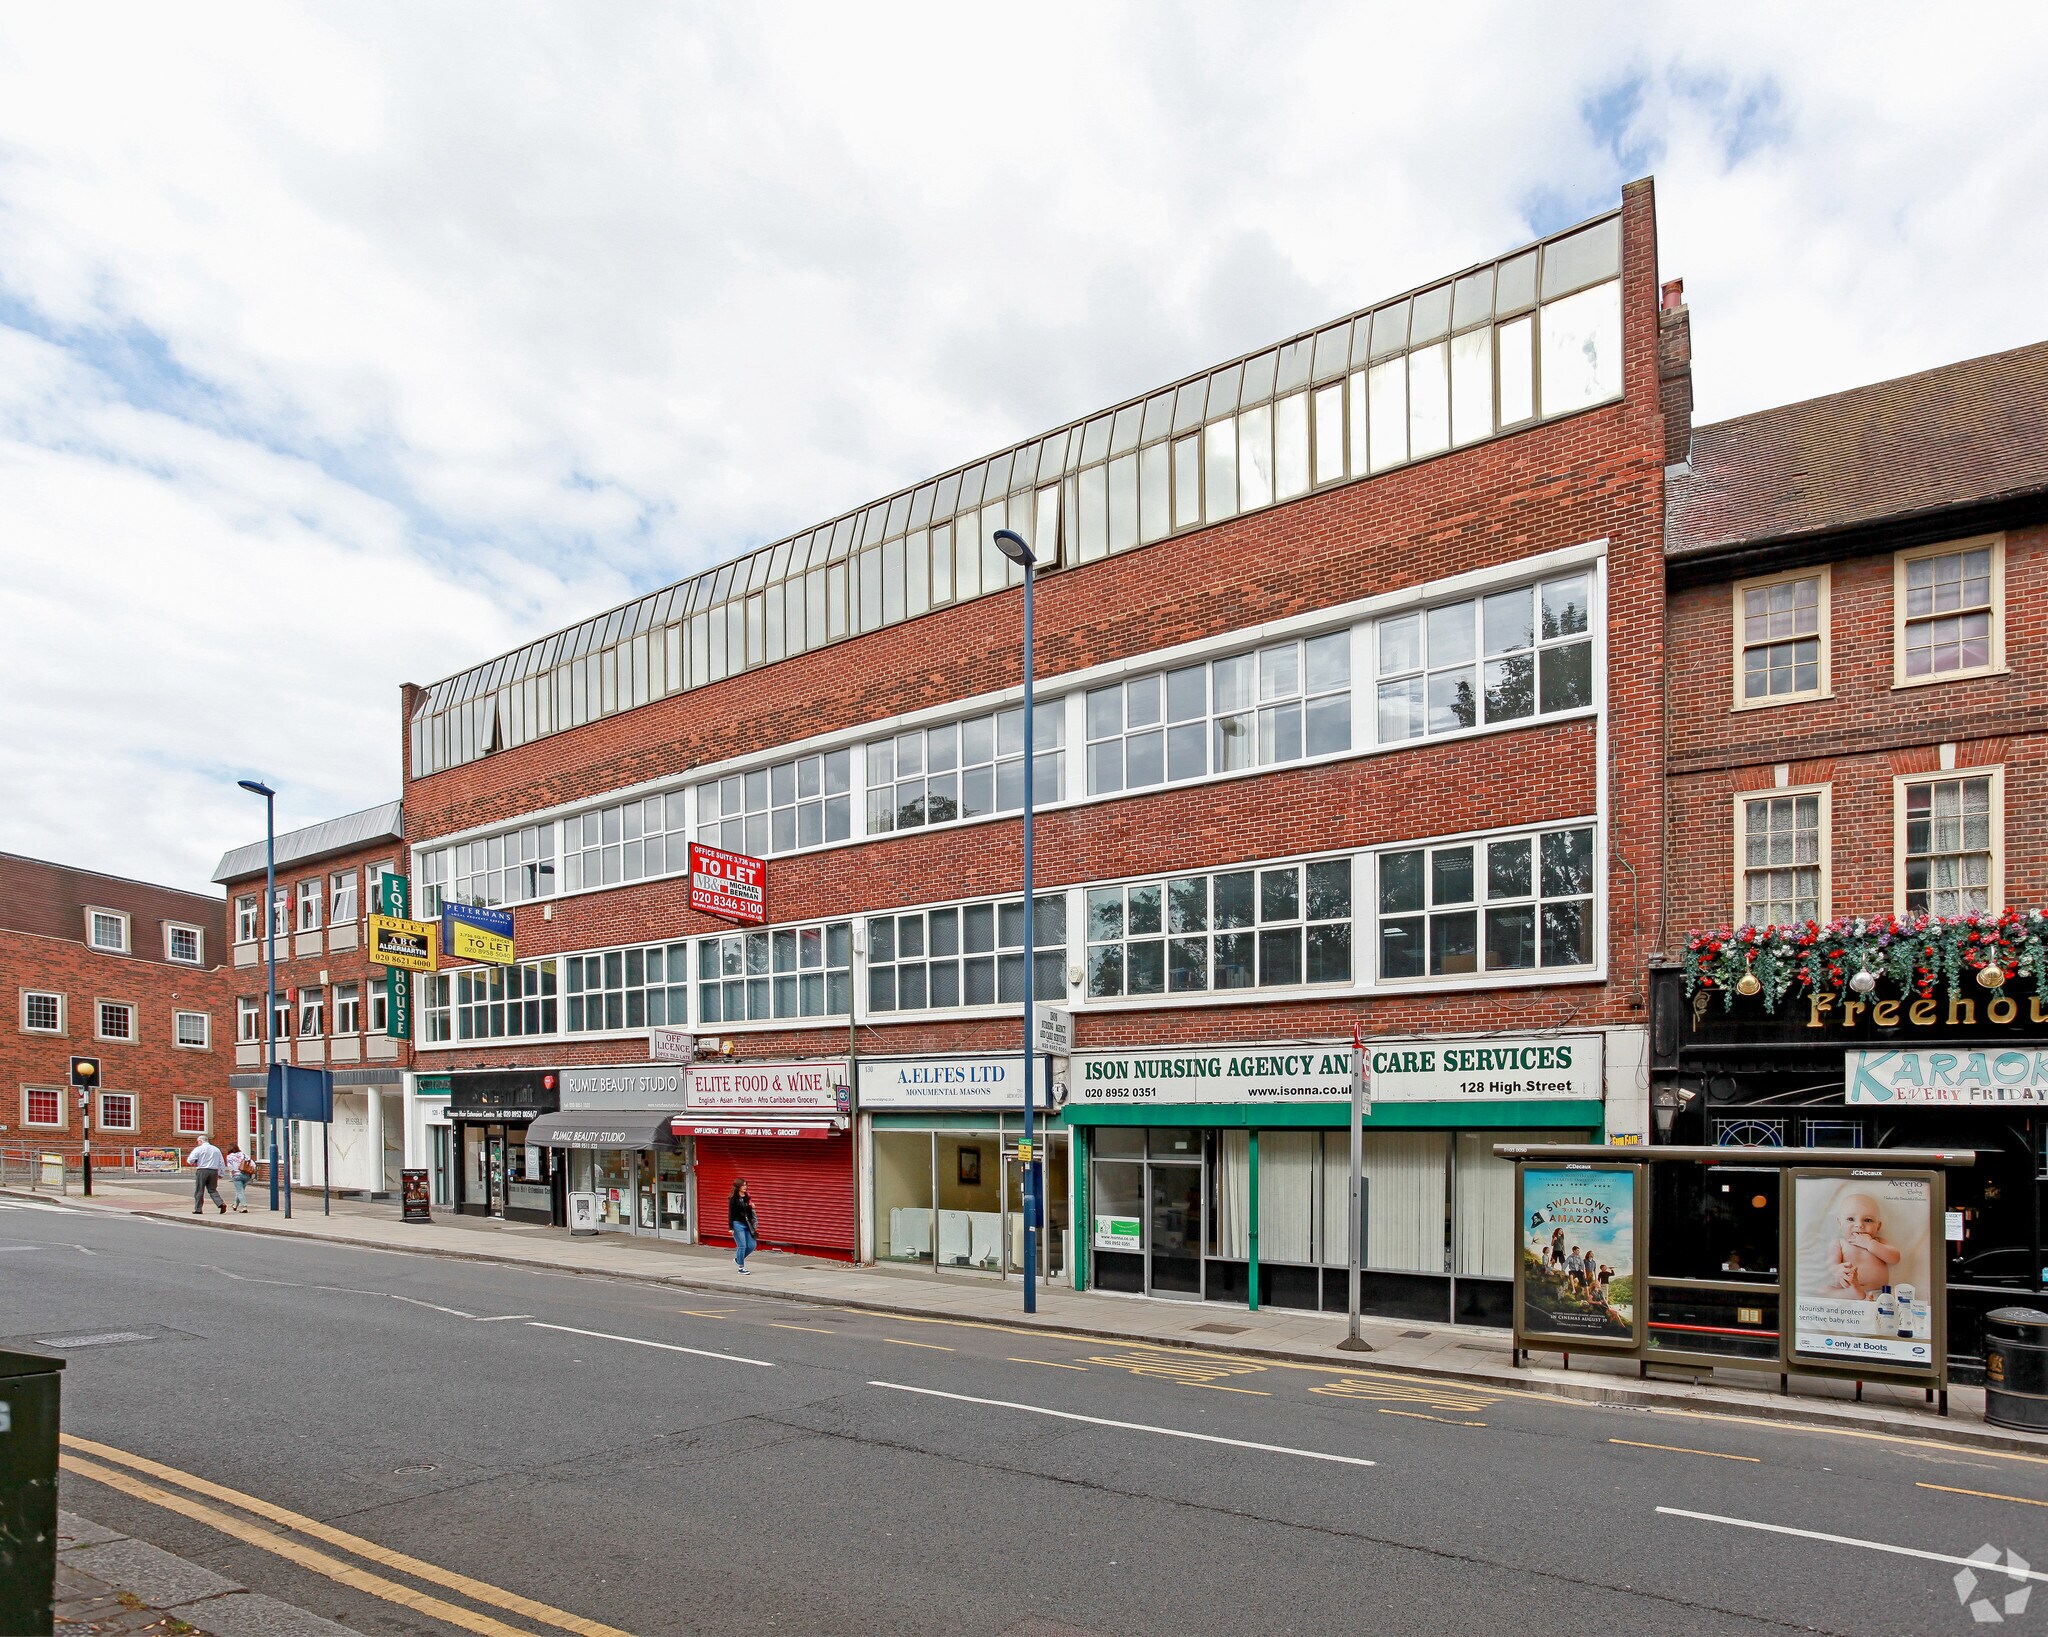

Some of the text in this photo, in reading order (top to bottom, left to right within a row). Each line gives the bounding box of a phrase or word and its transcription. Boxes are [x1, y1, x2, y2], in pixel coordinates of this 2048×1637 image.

[695, 847, 715, 857] OFFICE
[716, 852, 733, 862] SUITE
[734, 857, 748, 865] 3,736
[700, 857, 756, 884] TO LET
[730, 882, 759, 894] MICHAEL
[730, 889, 758, 900] BERMAN
[692, 891, 762, 914] 020 8346 5100
[447, 905, 511, 920] PETERMANS
[693, 902, 762, 920] www.michaelberman.co.uk
[376, 919, 397, 927] TO
[401, 923, 427, 933] LET
[379, 943, 426, 956] ALDERMARTIN
[468, 938, 510, 952] TO LET
[392, 956, 410, 964] 8621
[413, 959, 430, 967] 4000
[395, 970, 406, 1034] HOUSE
[666, 1034, 681, 1042] OFF
[658, 1042, 690, 1053] LICENCE
[1085, 1046, 1572, 1079] ISON NURSING AGENCY AN CARE SERVICES
[897, 1066, 1005, 1083] A.ELFES LTD
[570, 1076, 677, 1092] RUMIZ BEAUTY STUDIO
[695, 1072, 822, 1092] ELITE FOOD & WINE
[1460, 1080, 1572, 1094] 128 High Street
[1085, 1087, 1156, 1098] 020 8952 0351
[1896, 1088, 1961, 1100] EVERY
[699, 1097, 715, 1105] English
[770, 1096, 796, 1104] Caribbean
[798, 1097, 818, 1105] Grocery
[552, 1131, 625, 1142] RUMIZ BEAUTY STUDIO
[1625, 1135, 1638, 1145] FAIR
[1546, 1197, 1611, 1214] SWALLOWS
[1549, 1215, 1608, 1224] AMAZONS
[1799, 1305, 1824, 1313] Nourish
[1841, 1309, 1864, 1317] protect
[1799, 1315, 1827, 1323] sensitive
[1829, 1316, 1845, 1325] baby
[1835, 1341, 1850, 1349] only
[1864, 1343, 1887, 1351] Boots
